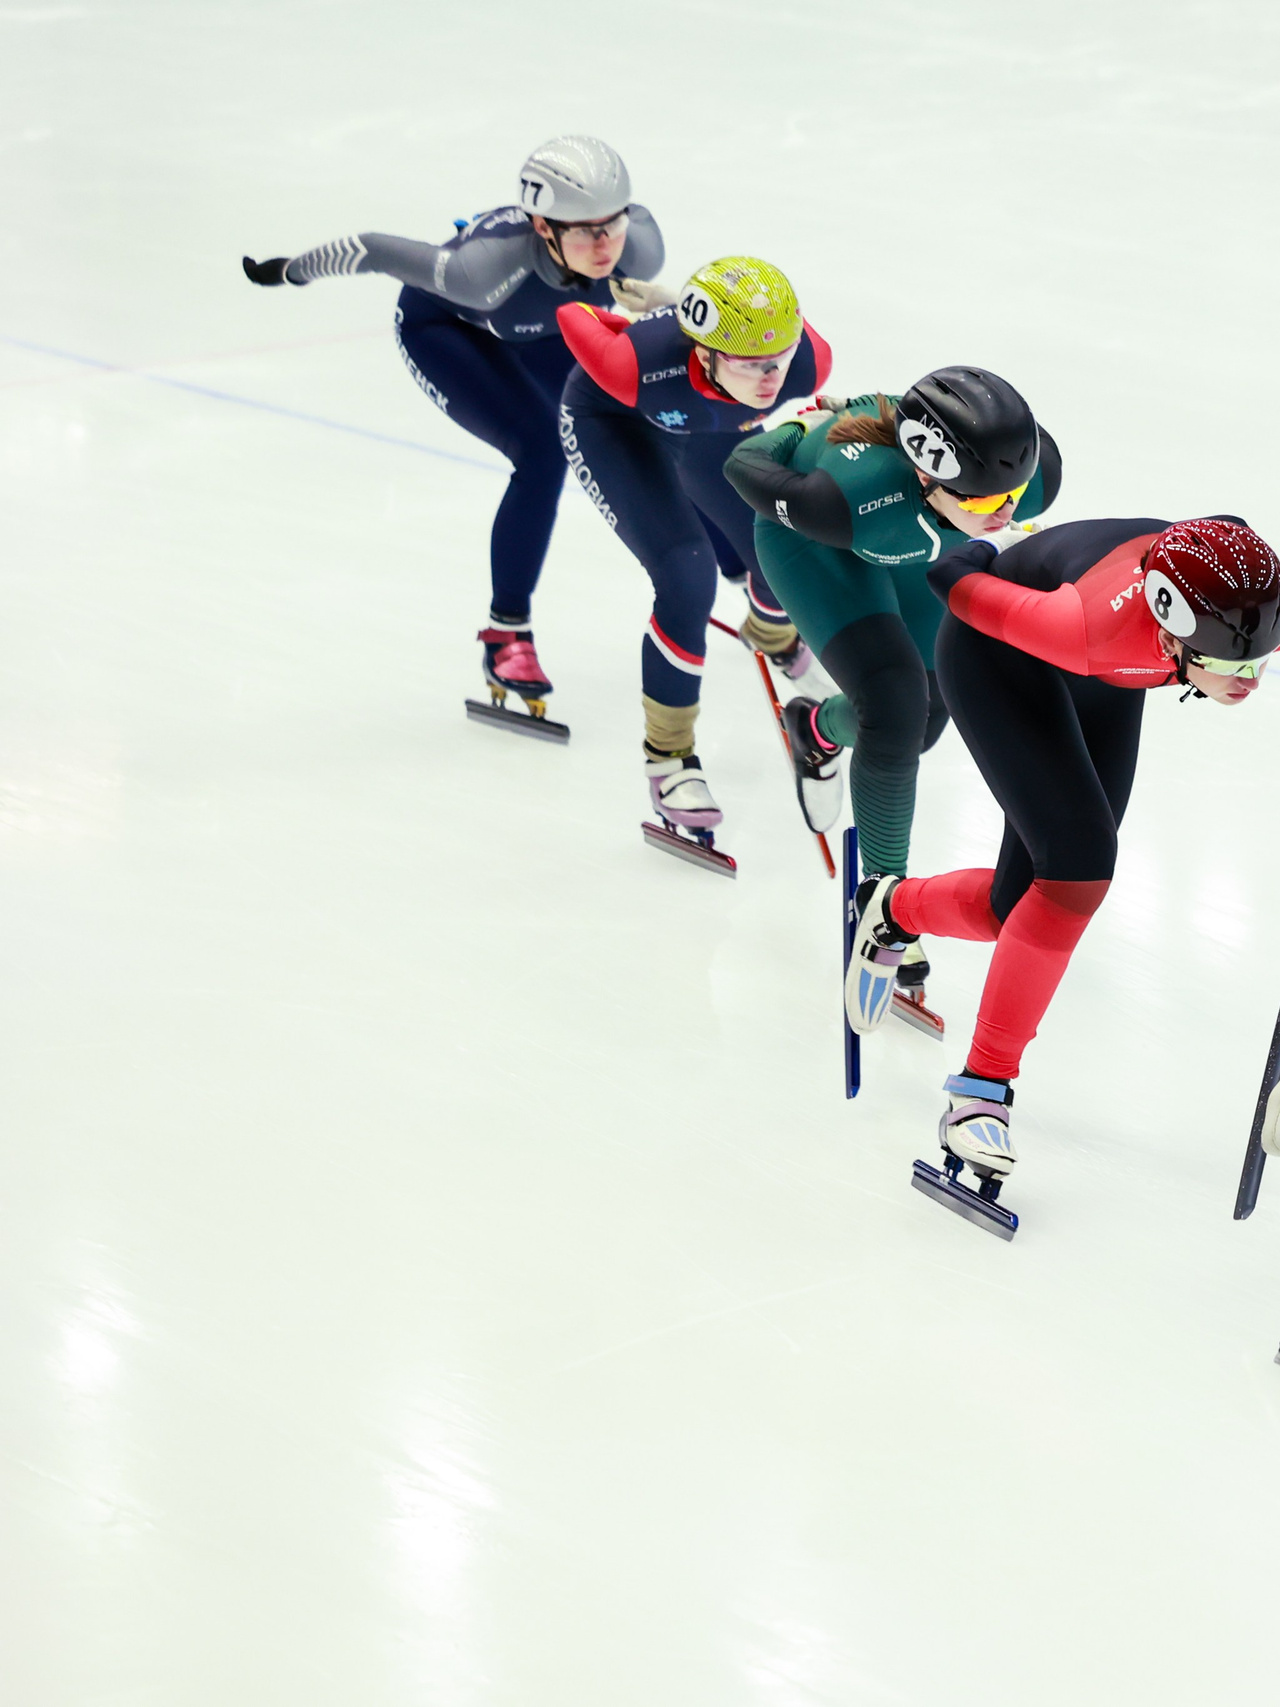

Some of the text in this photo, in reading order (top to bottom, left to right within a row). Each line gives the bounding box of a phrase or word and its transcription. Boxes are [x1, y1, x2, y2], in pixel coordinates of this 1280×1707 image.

[521, 178, 544, 206] 77
[681, 293, 708, 327] 40
[394, 306, 449, 413] СЛЕНСК
[642, 365, 688, 384] corsa
[560, 404, 618, 530] МОРДОВИЯ
[906, 434, 946, 473] 41
[858, 491, 906, 515] corsa
[1154, 587, 1172, 620] 8
